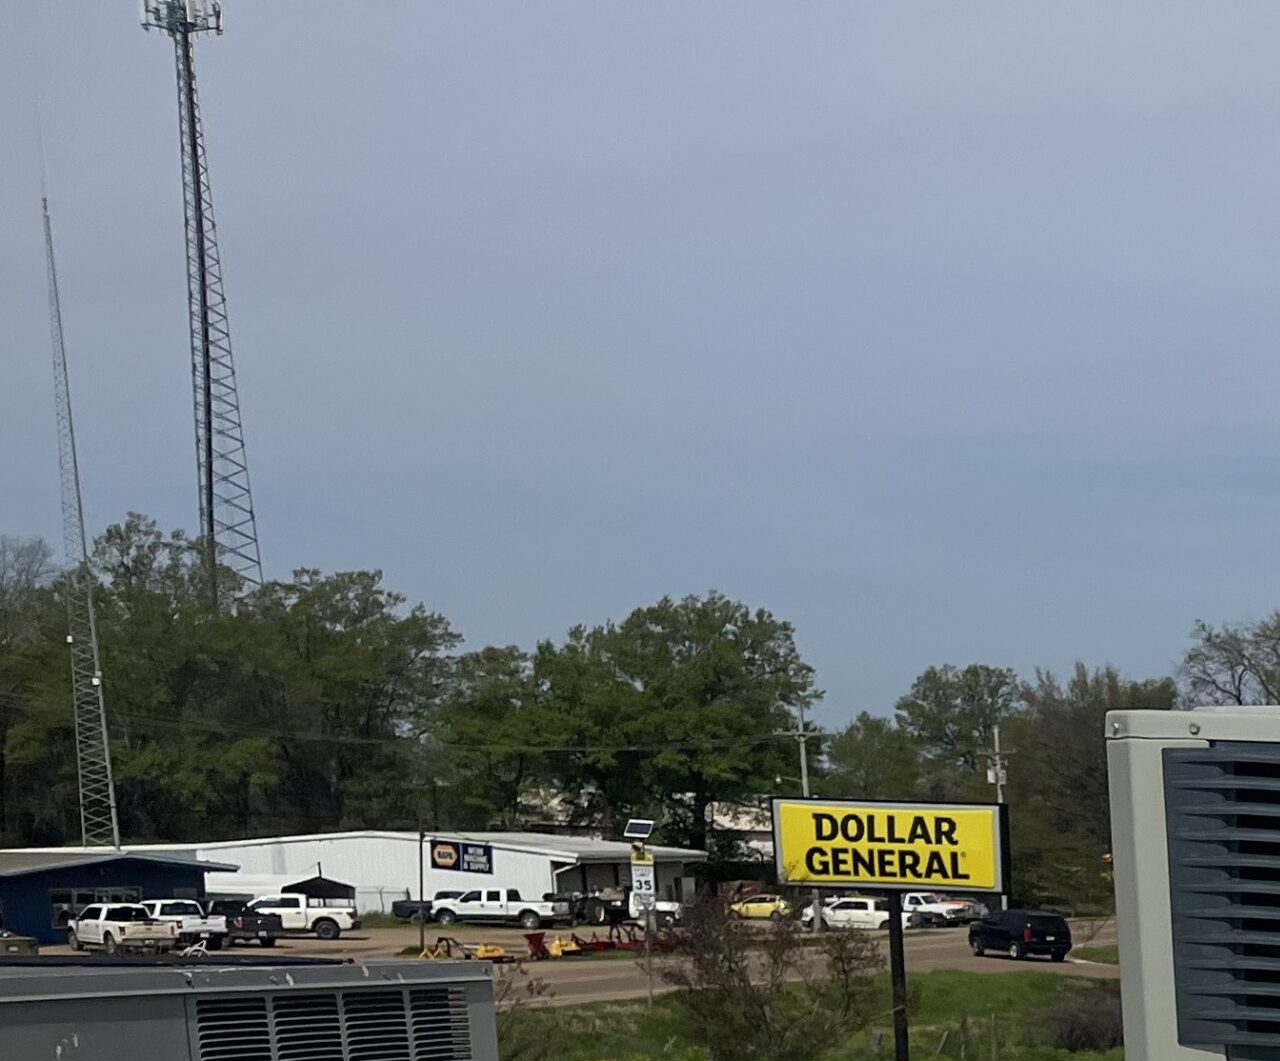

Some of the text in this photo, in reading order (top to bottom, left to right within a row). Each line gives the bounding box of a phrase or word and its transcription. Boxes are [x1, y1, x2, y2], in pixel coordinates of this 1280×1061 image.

[812, 813, 958, 845] DOLLAR
[805, 847, 970, 880] GENERAL
[635, 880, 652, 891] 35
